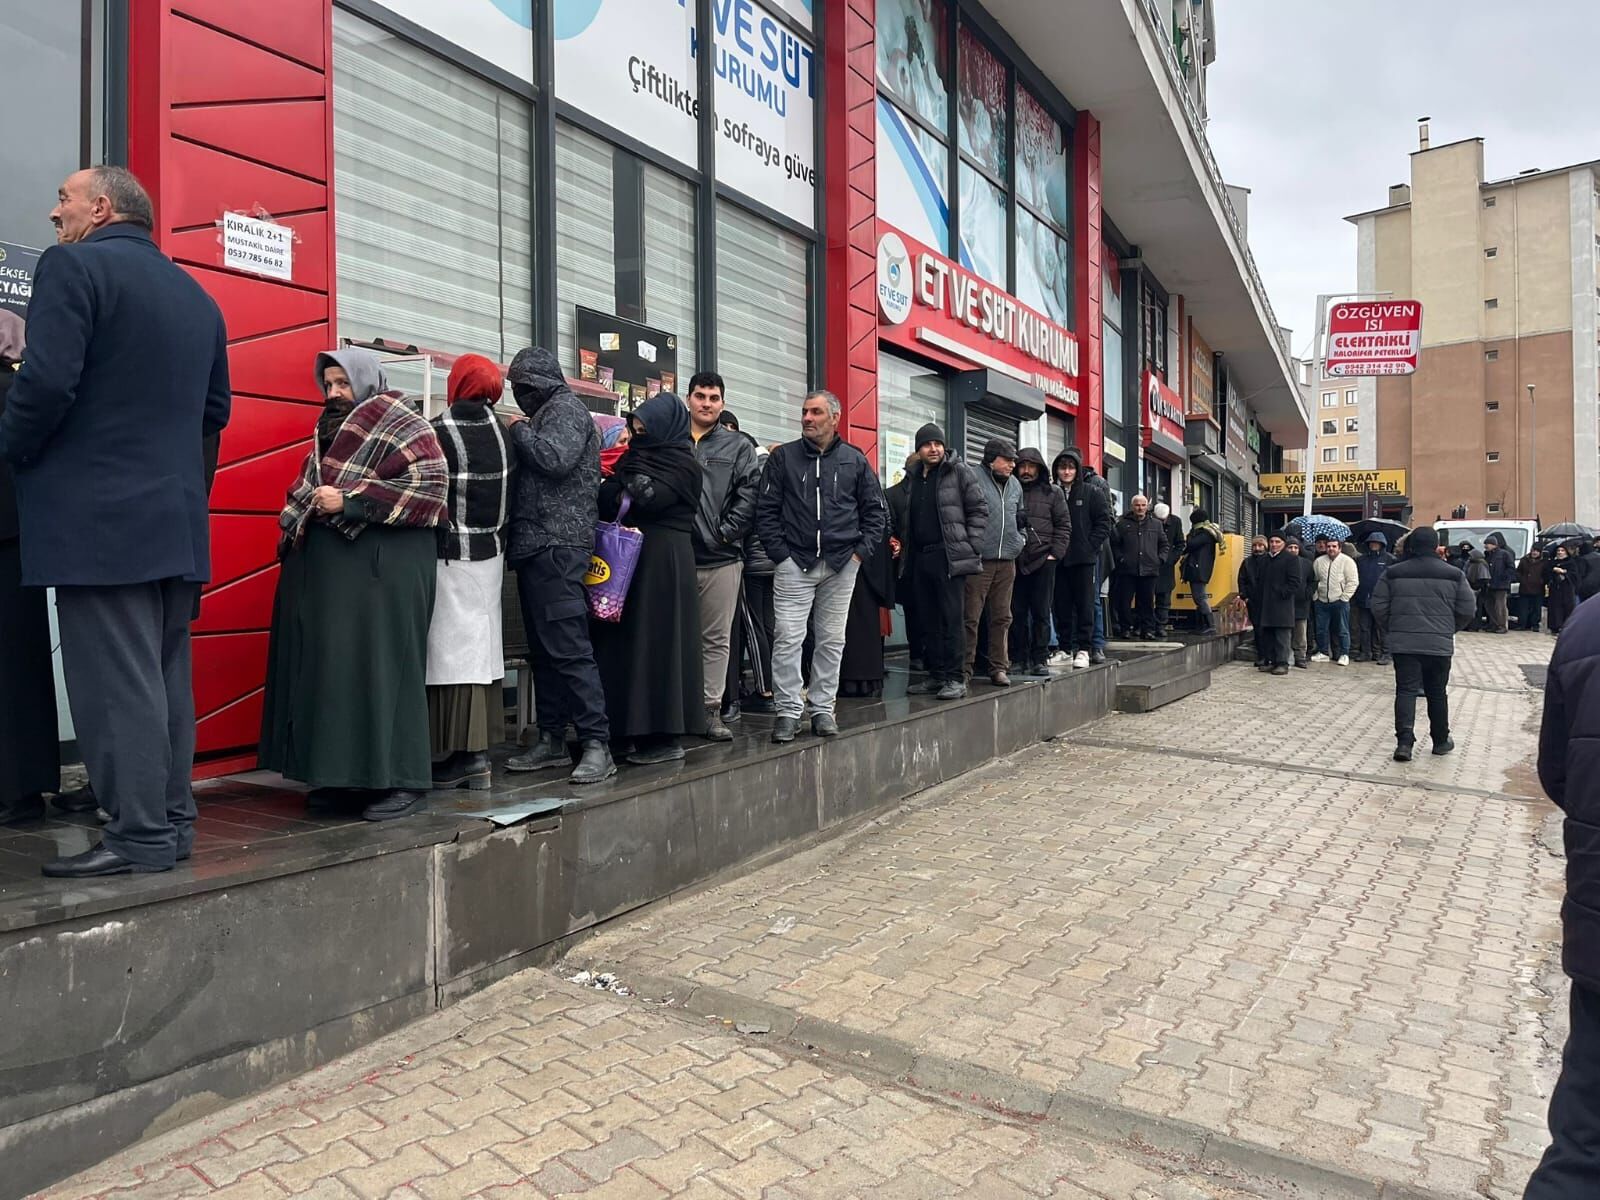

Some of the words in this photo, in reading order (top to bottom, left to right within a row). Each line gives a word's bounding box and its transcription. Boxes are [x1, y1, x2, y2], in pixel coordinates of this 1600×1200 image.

[723, 118, 780, 167] sofraya
[227, 219, 265, 238] KIRALIK
[267, 230, 284, 243] 2+1
[227, 248, 247, 259] 0537
[248, 252, 262, 263] 785
[263, 257, 273, 265] 66
[274, 259, 283, 268] 82
[880, 283, 888, 297] ET
[918, 252, 949, 310] ET
[951, 268, 979, 327] VE
[980, 287, 1017, 344] SÜT
[1018, 307, 1079, 378] KURUMU
[1336, 303, 1415, 319] ÖZGÜVEN
[1365, 319, 1383, 330] ISI
[1337, 471, 1380, 485] İNŞAAT
[1286, 484, 1306, 494] YAP
[588, 561, 606, 576] atis
